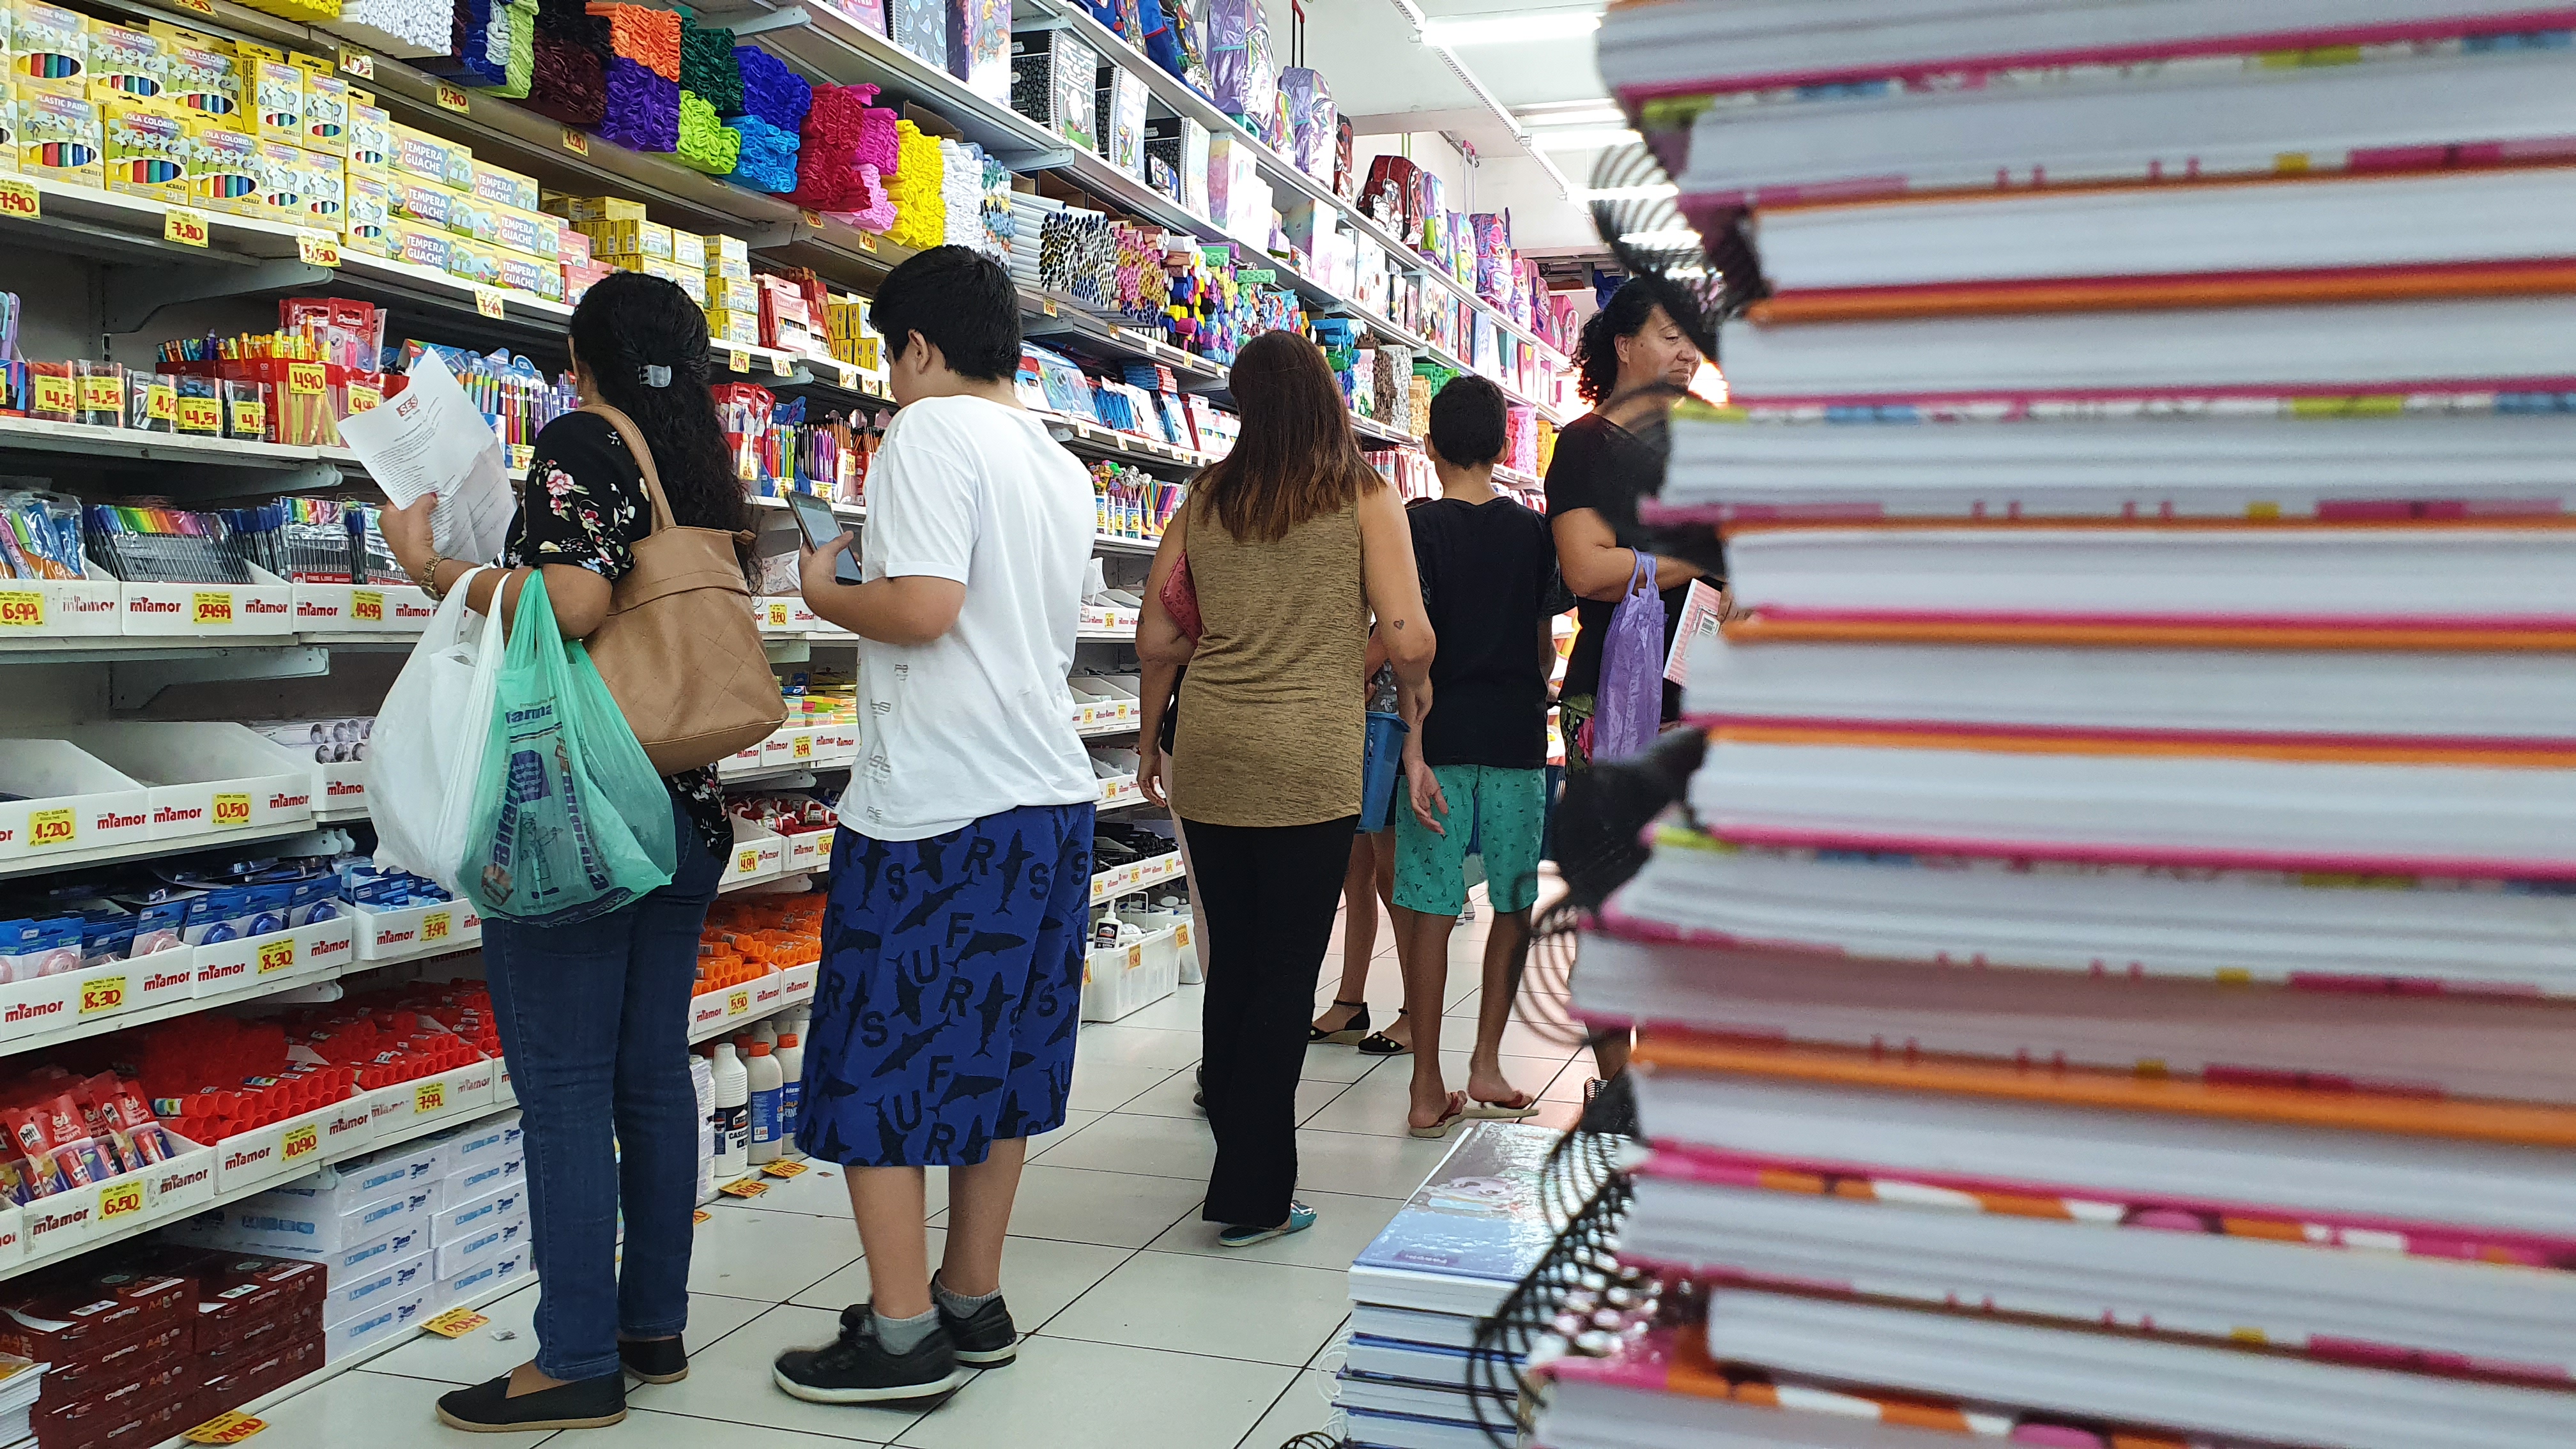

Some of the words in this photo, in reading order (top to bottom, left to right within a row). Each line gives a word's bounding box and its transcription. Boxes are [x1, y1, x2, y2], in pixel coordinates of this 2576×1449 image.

[36, 95, 65, 107] PLASTIC
[66, 100, 89, 112] PAINT
[122, 112, 142, 123] COLA
[143, 116, 179, 130] COLORIDA
[221, 134, 254, 147] COLORIDA
[404, 141, 443, 161] TEMPERA
[405, 153, 441, 173] GUACHE
[478, 174, 512, 193] TEMPERA
[408, 188, 446, 208] TEMPERA
[479, 186, 510, 204] GUACHE
[409, 203, 444, 220] GUACHE
[501, 217, 534, 236] TEMPERA
[407, 236, 445, 254] TEMPERA
[502, 228, 533, 246] GUACHE
[407, 248, 443, 266] GUACHE
[503, 261, 537, 278] TEMPERA
[503, 273, 535, 289] GUACHE
[2, 602, 38, 621] 6.99
[130, 597, 181, 613] miamor
[245, 599, 288, 613] miamor
[297, 601, 338, 617] miamor
[395, 603, 431, 617] miamor
[270, 793, 309, 809] miamor
[97, 813, 147, 830] miamor
[153, 806, 202, 824] miamor
[377, 930, 415, 946] miamor
[311, 939, 350, 957] miamor
[144, 971, 190, 992] miamor
[197, 963, 245, 982] miamor
[5, 1000, 64, 1023] miamor
[696, 1008, 722, 1023] miamor
[226, 1146, 272, 1170] miamor
[33, 1208, 90, 1236] miamor
